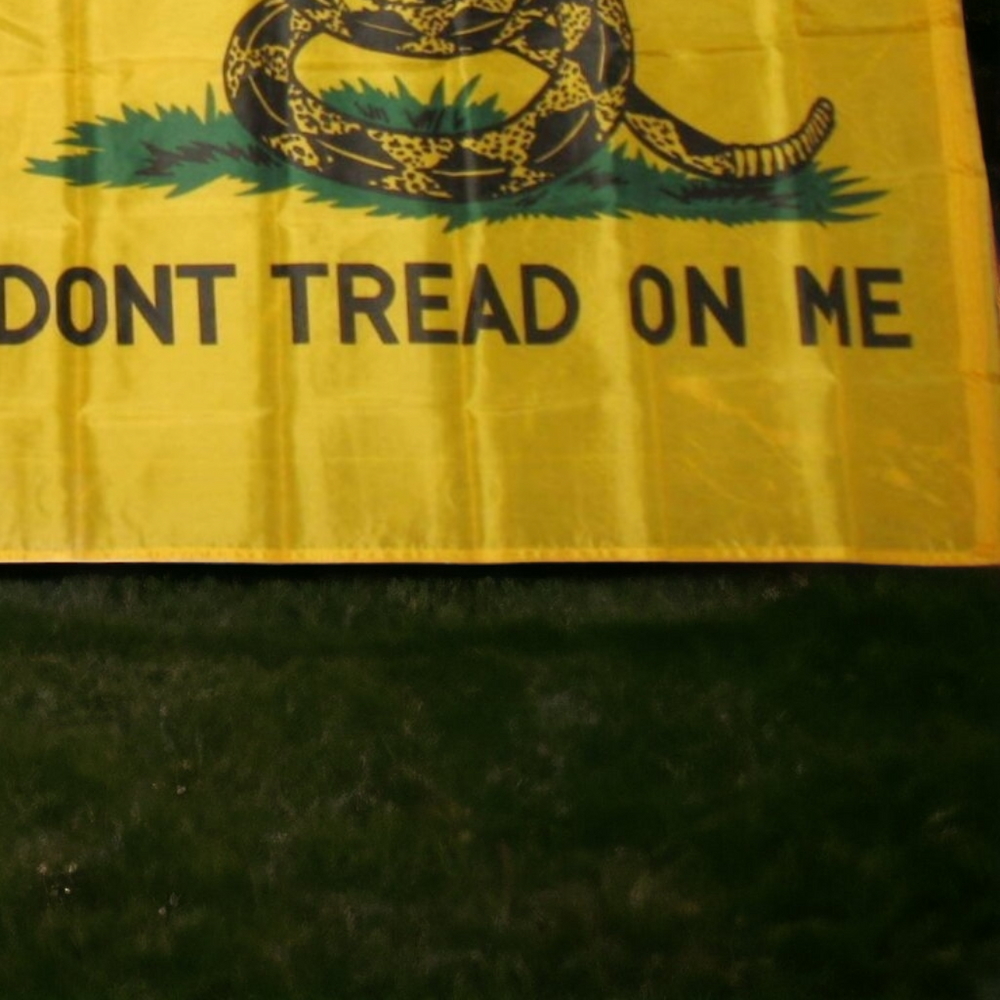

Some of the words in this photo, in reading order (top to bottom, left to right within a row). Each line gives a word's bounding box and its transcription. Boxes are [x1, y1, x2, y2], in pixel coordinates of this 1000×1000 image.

[271, 264, 580, 345] TREAD
[630, 266, 747, 347] ON
[800, 267, 913, 348] ME
